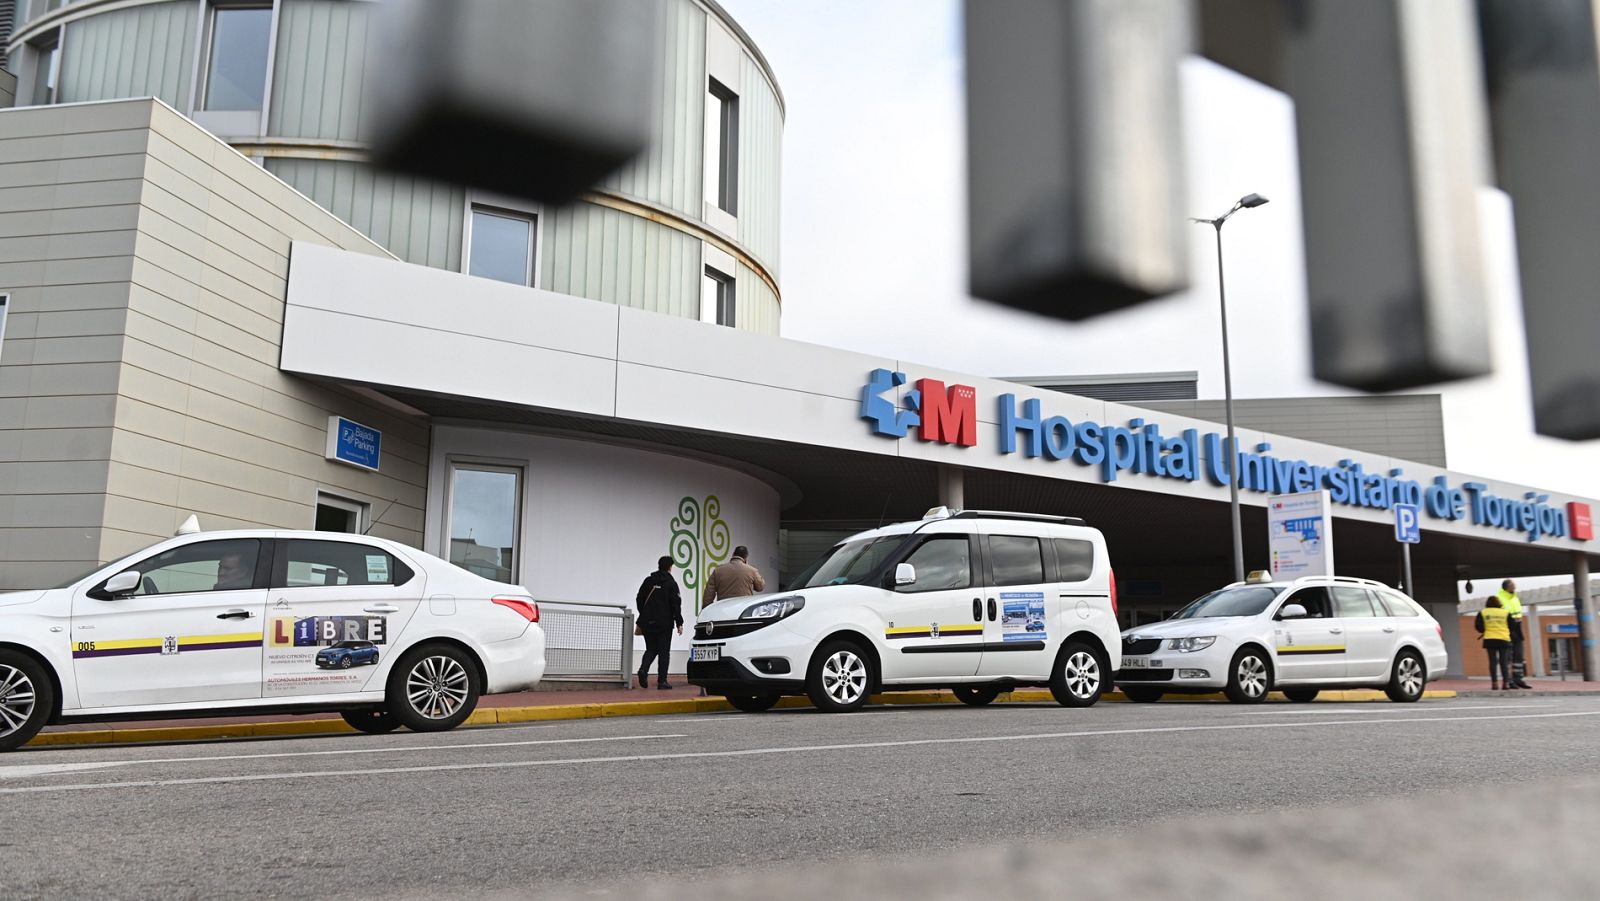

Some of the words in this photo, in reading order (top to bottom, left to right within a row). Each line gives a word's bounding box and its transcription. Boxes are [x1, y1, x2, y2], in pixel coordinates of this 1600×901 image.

[916, 378, 977, 447] M
[354, 438, 375, 454] Parking
[998, 392, 1200, 482] Hospital
[1204, 432, 1423, 512] Universitario
[1427, 475, 1466, 521] de
[1463, 482, 1567, 542] Torrejón
[1400, 509, 1415, 537] P
[78, 641, 96, 652] 005
[694, 650, 706, 660] 3557
[707, 649, 717, 660] KYP
